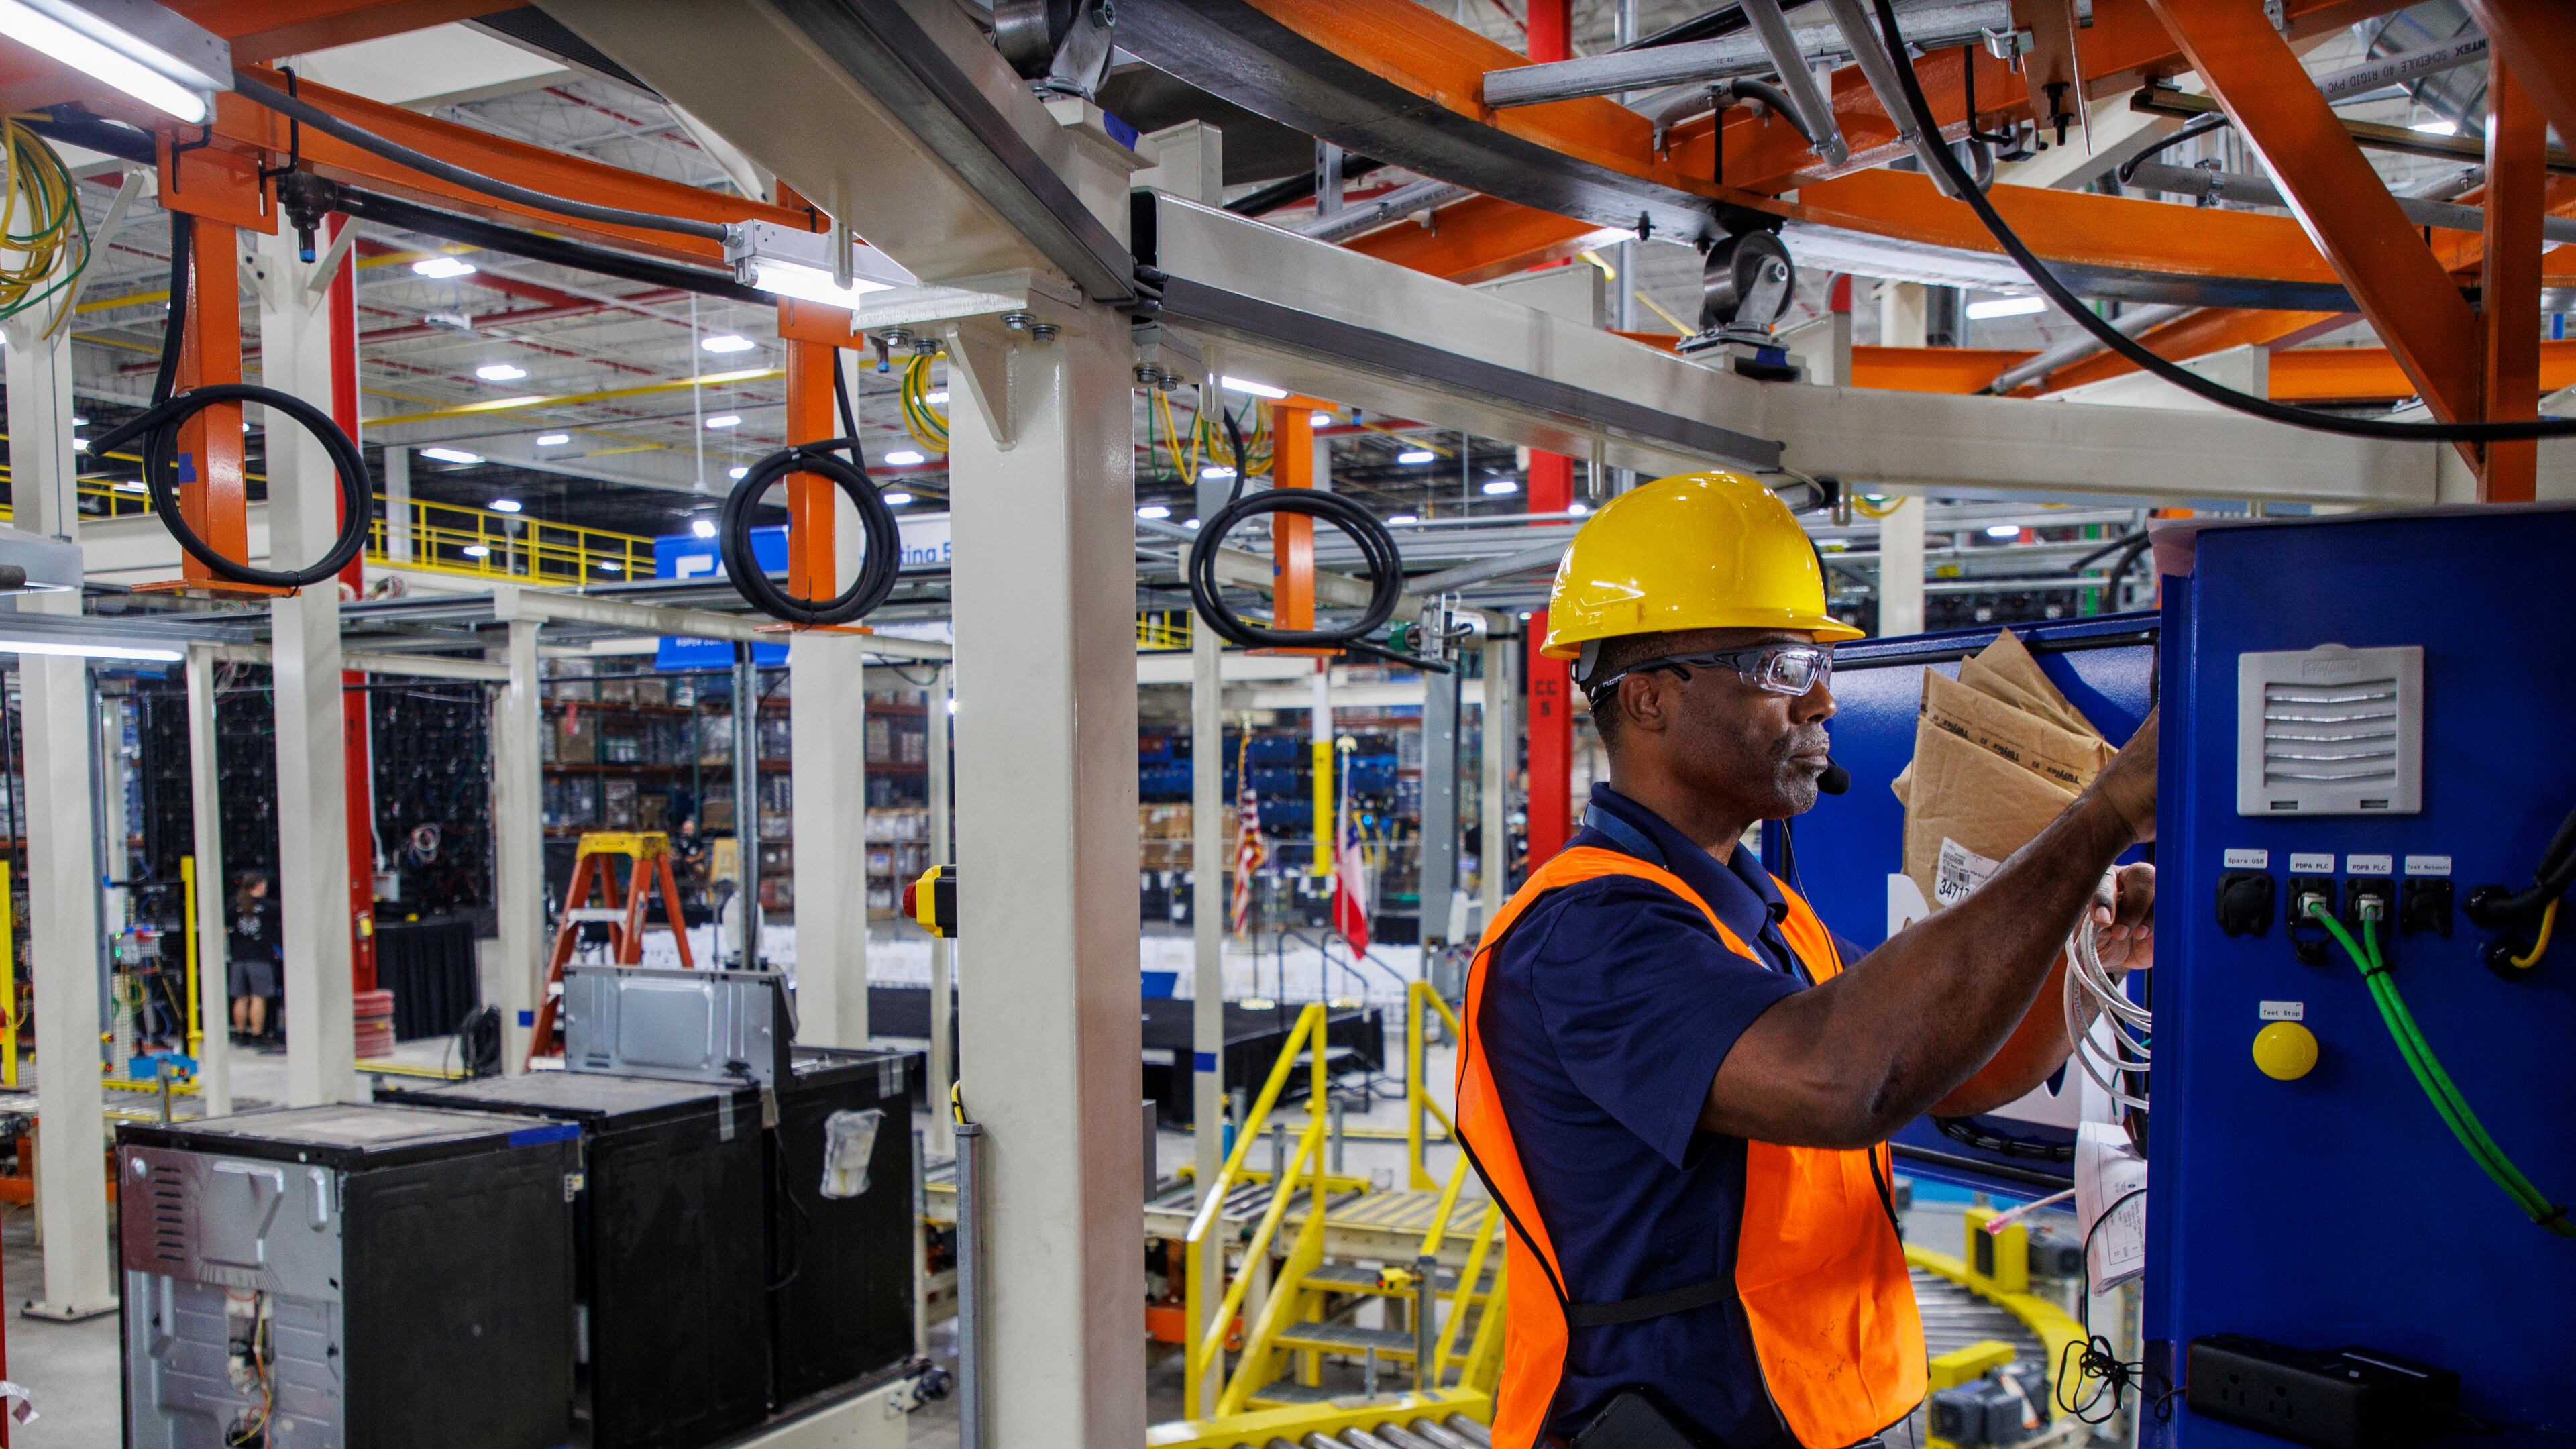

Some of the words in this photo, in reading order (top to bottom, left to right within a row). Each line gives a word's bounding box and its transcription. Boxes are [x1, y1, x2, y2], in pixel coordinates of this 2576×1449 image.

[2401, 50, 2447, 72] SCHEDULE
[2383, 66, 2394, 77] 40
[2350, 71, 2379, 87] RIGID
[2328, 80, 2345, 93] PVC
